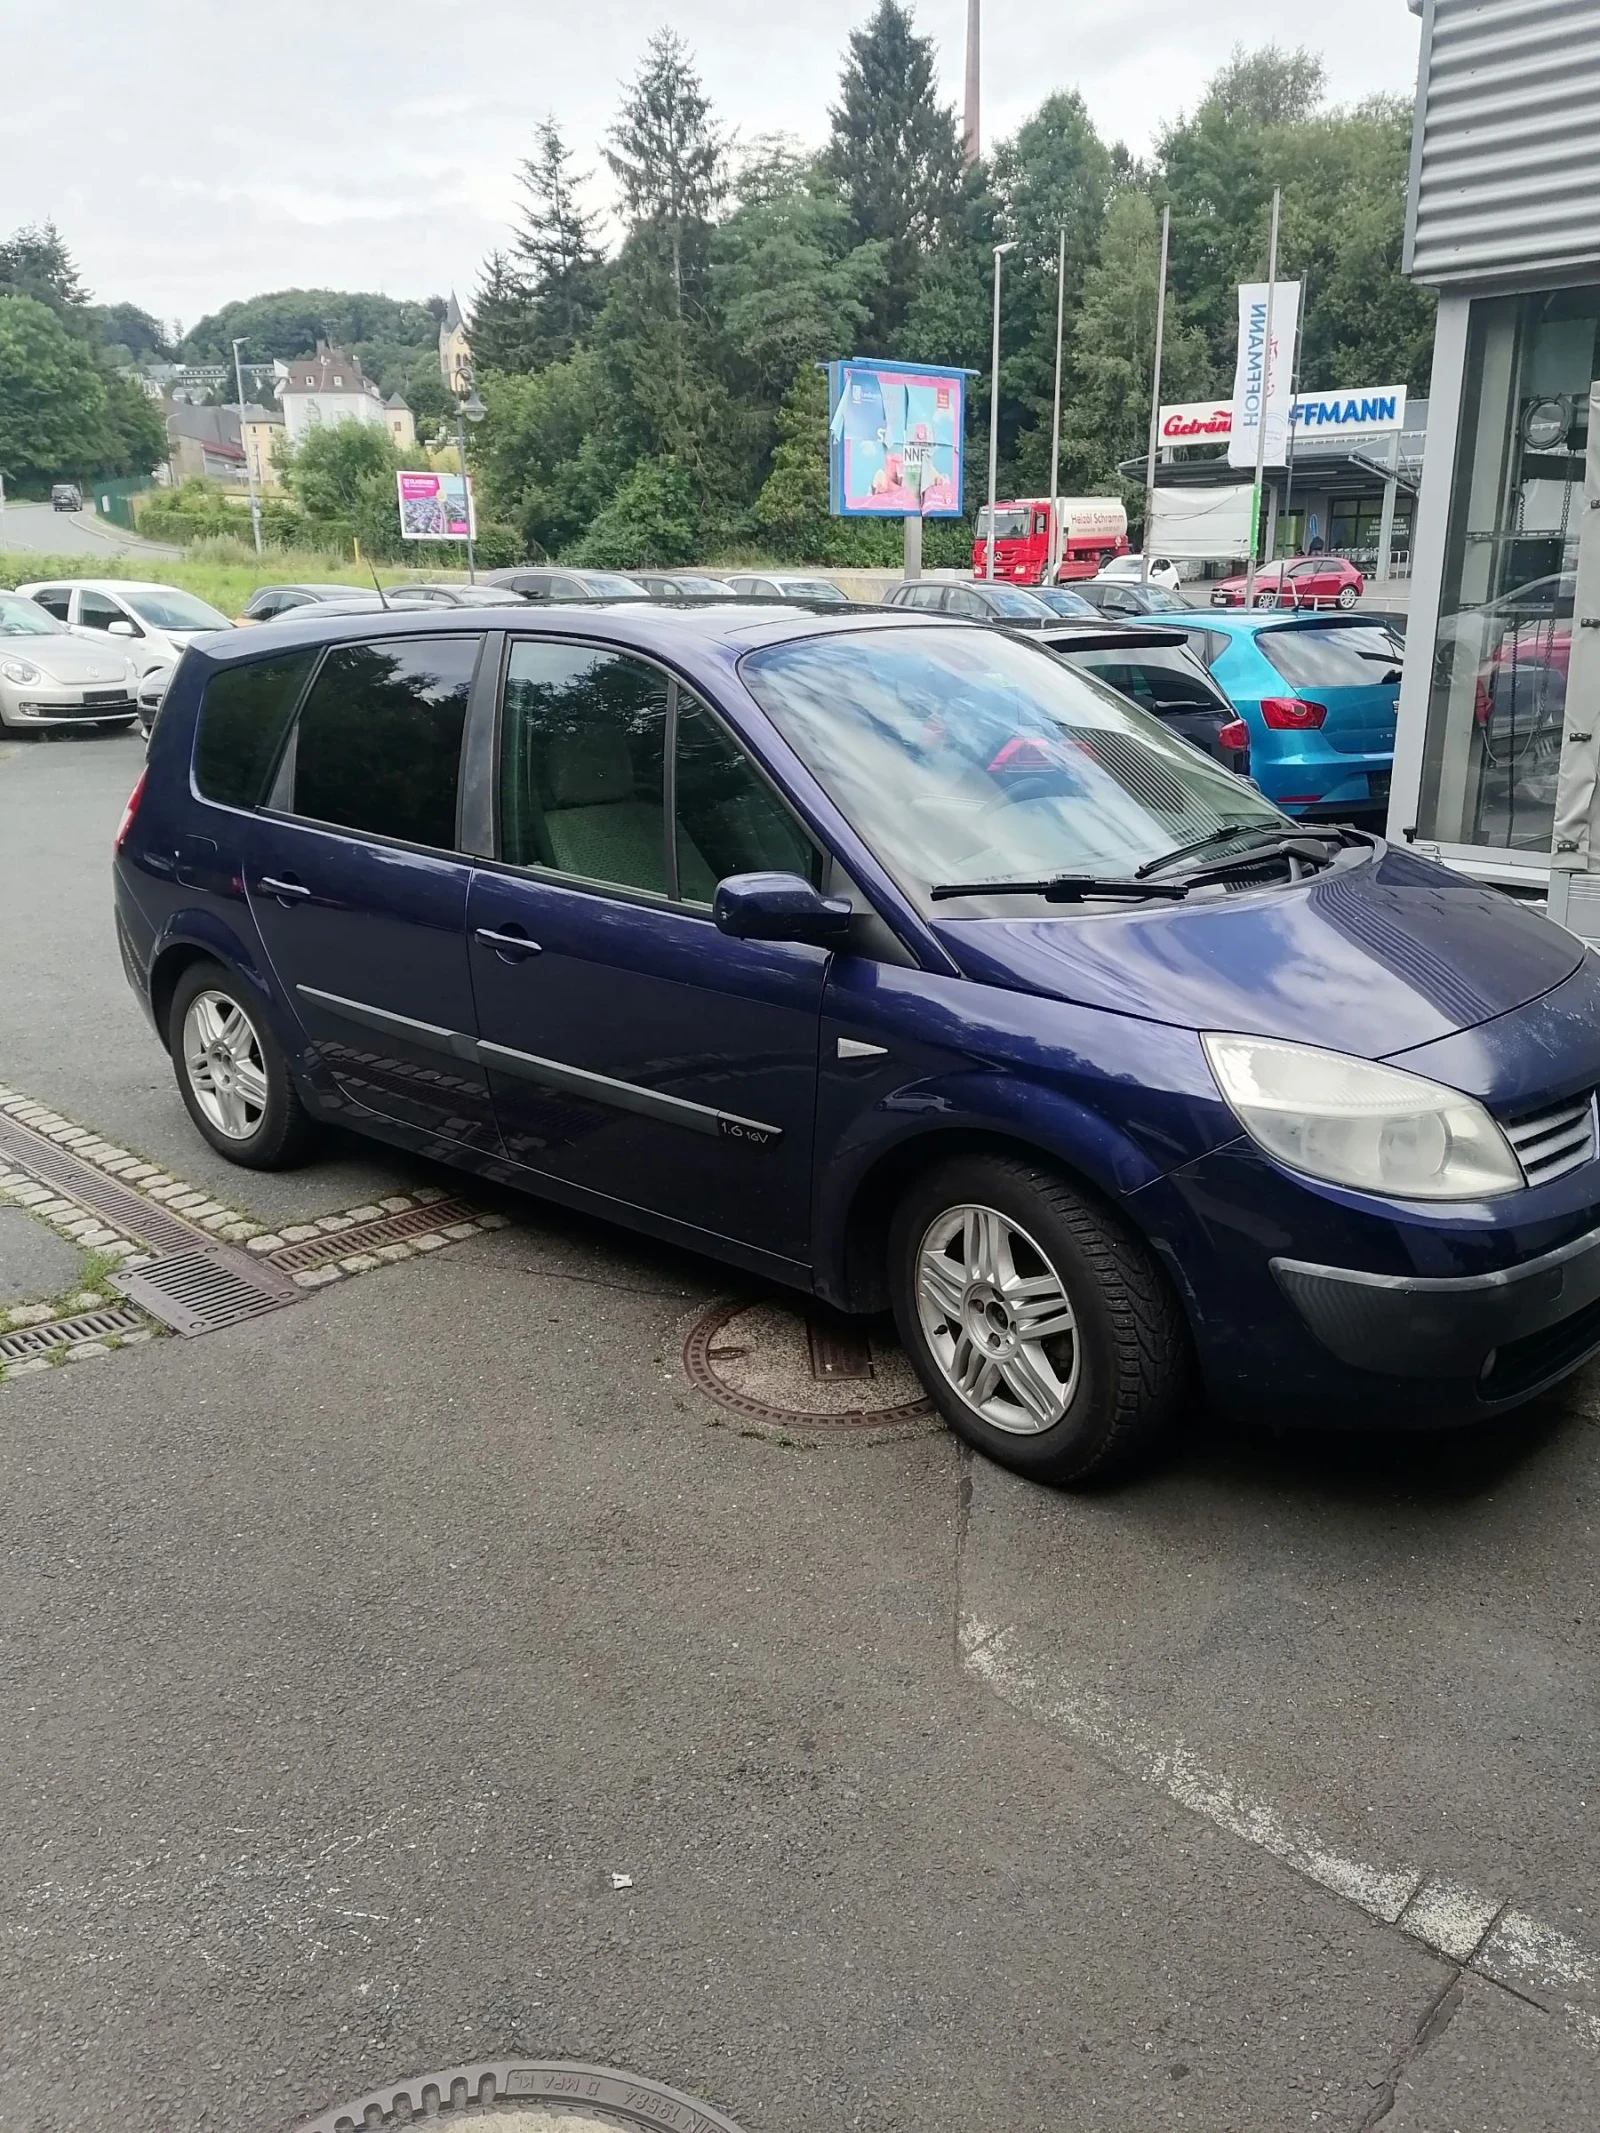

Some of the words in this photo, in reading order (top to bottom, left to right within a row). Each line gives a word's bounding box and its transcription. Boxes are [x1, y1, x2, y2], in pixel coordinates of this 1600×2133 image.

[1289, 396, 1397, 426] FFMANN
[721, 1121, 744, 1137] 1.6
[746, 1131, 769, 1144] 16V
[544, 2076, 581, 2092] MPA
[623, 2088, 682, 2123] 19584
